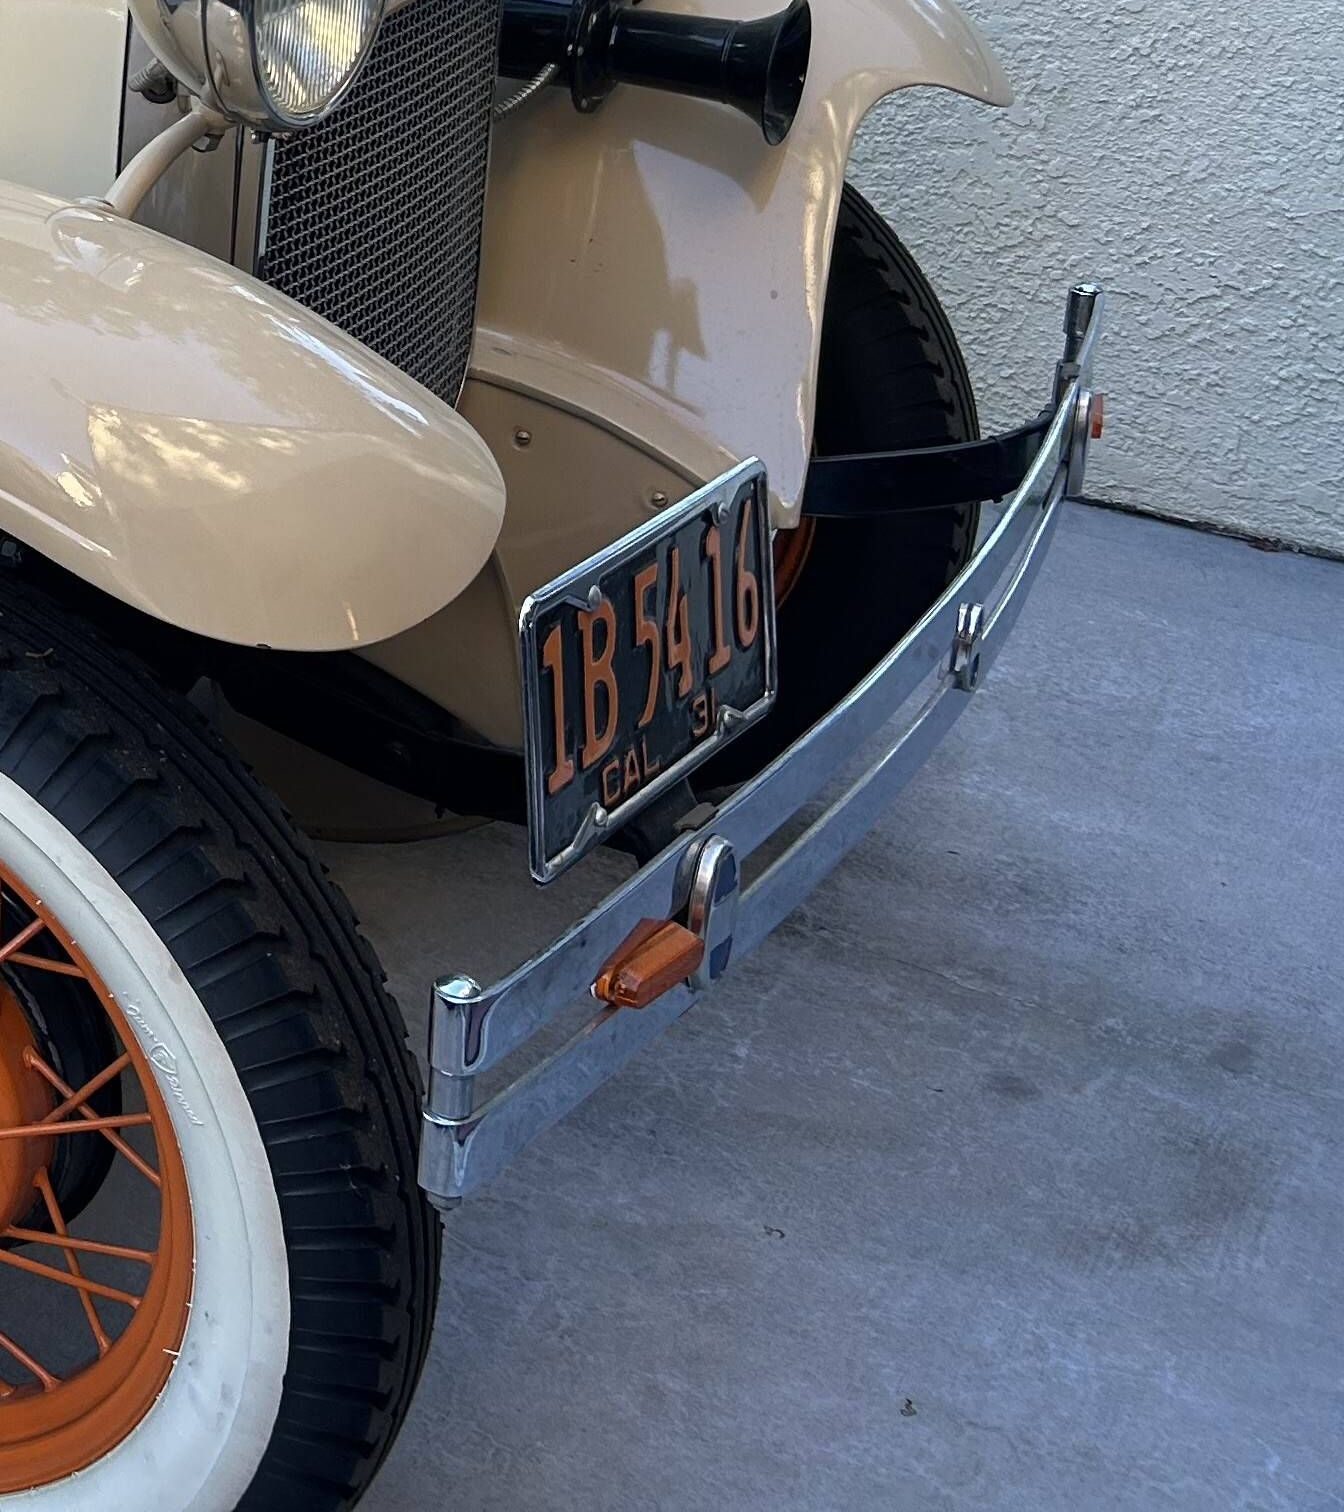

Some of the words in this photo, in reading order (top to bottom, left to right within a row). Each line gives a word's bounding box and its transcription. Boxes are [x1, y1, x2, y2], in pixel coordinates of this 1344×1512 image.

[543, 599, 618, 794] 1B
[634, 545, 693, 728] 54
[706, 500, 760, 674] 16
[602, 737, 660, 806] CAL
